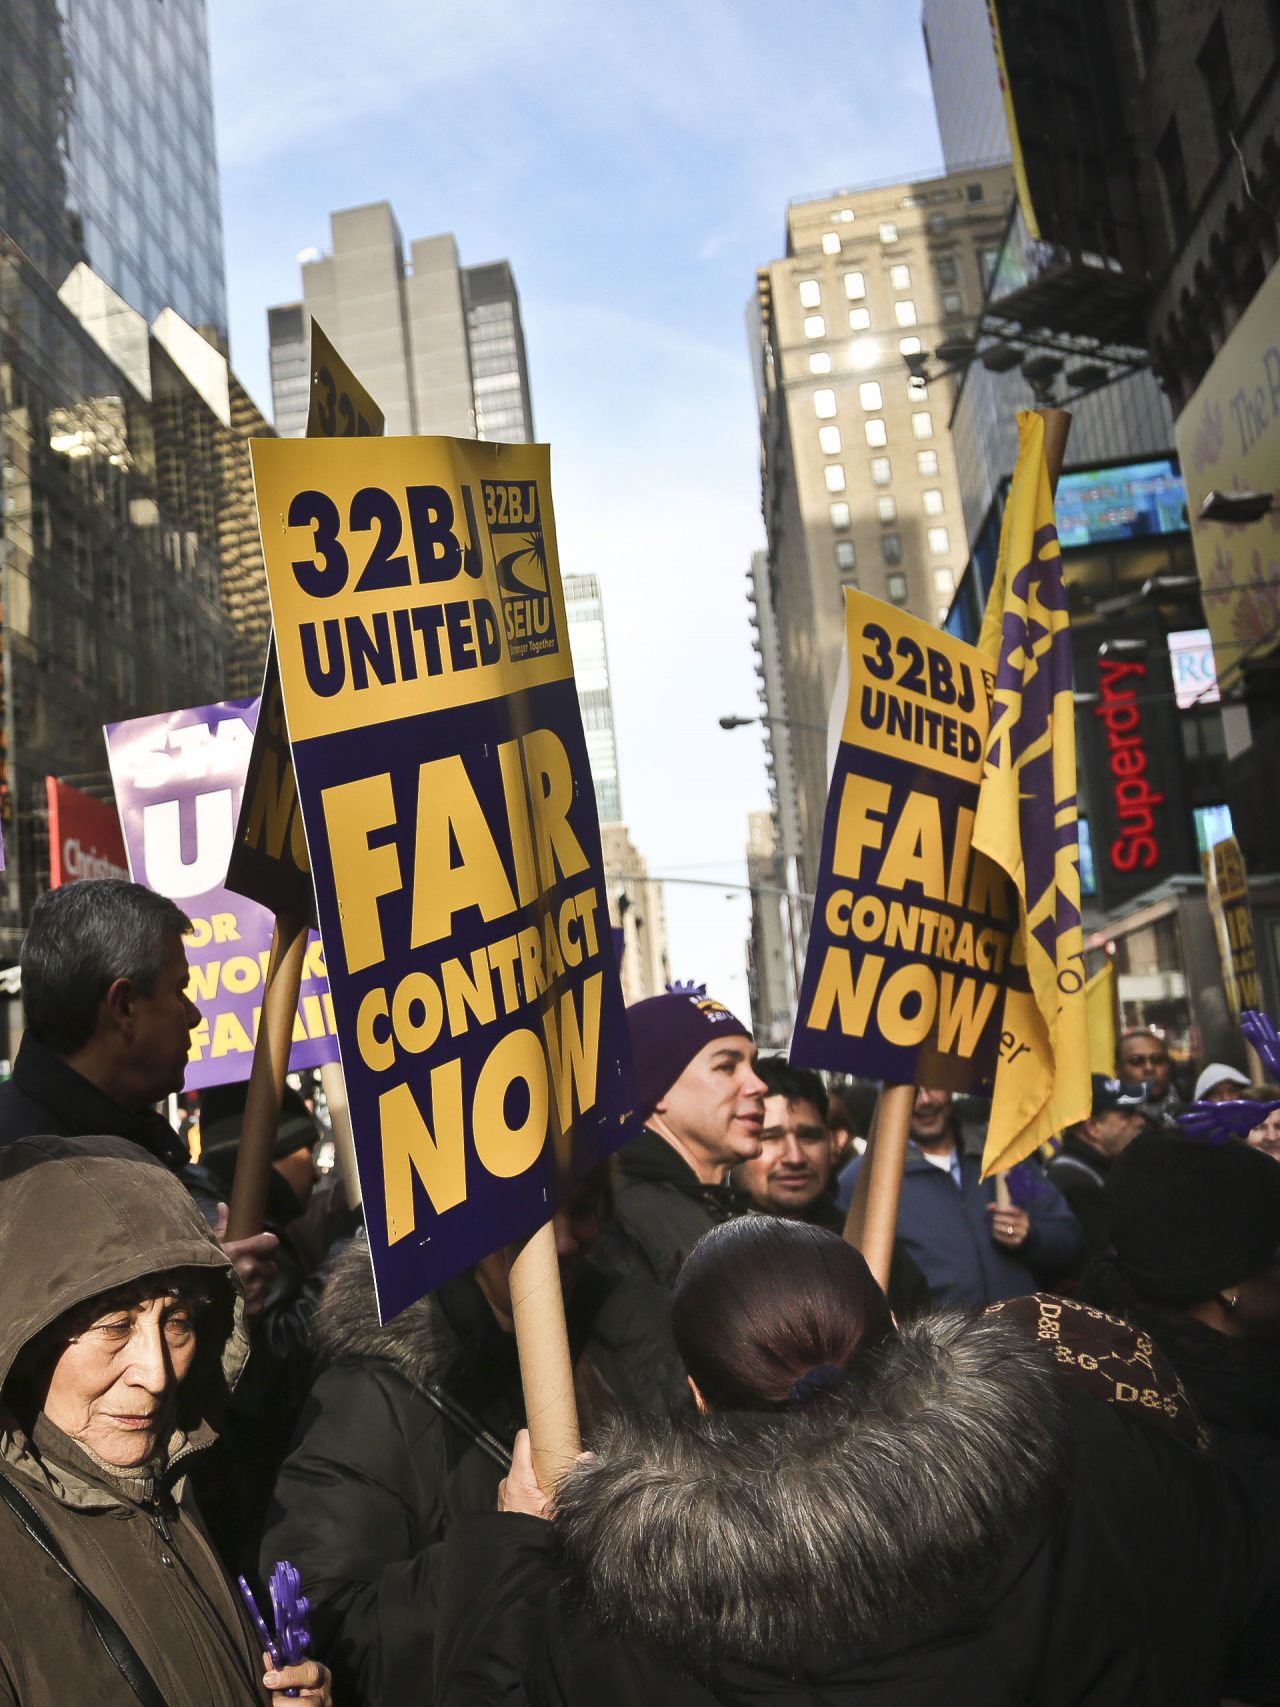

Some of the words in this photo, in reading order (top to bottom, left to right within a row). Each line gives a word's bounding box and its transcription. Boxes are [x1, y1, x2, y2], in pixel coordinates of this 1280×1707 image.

[287, 484, 485, 599] 32BJ
[485, 485, 536, 525] 32BJ
[299, 597, 502, 697] UNITED
[504, 597, 549, 640] SEIU
[862, 623, 976, 713] 32BJ
[860, 685, 982, 764] UNITED
[1094, 659, 1164, 873] Superdry
[321, 728, 590, 975] FAIR
[181, 913, 242, 948] OR
[356, 887, 598, 1072] CONTRACT
[826, 889, 1009, 975] CONTRACT
[807, 946, 1001, 1058] NOW
[378, 972, 603, 1247] NOW
